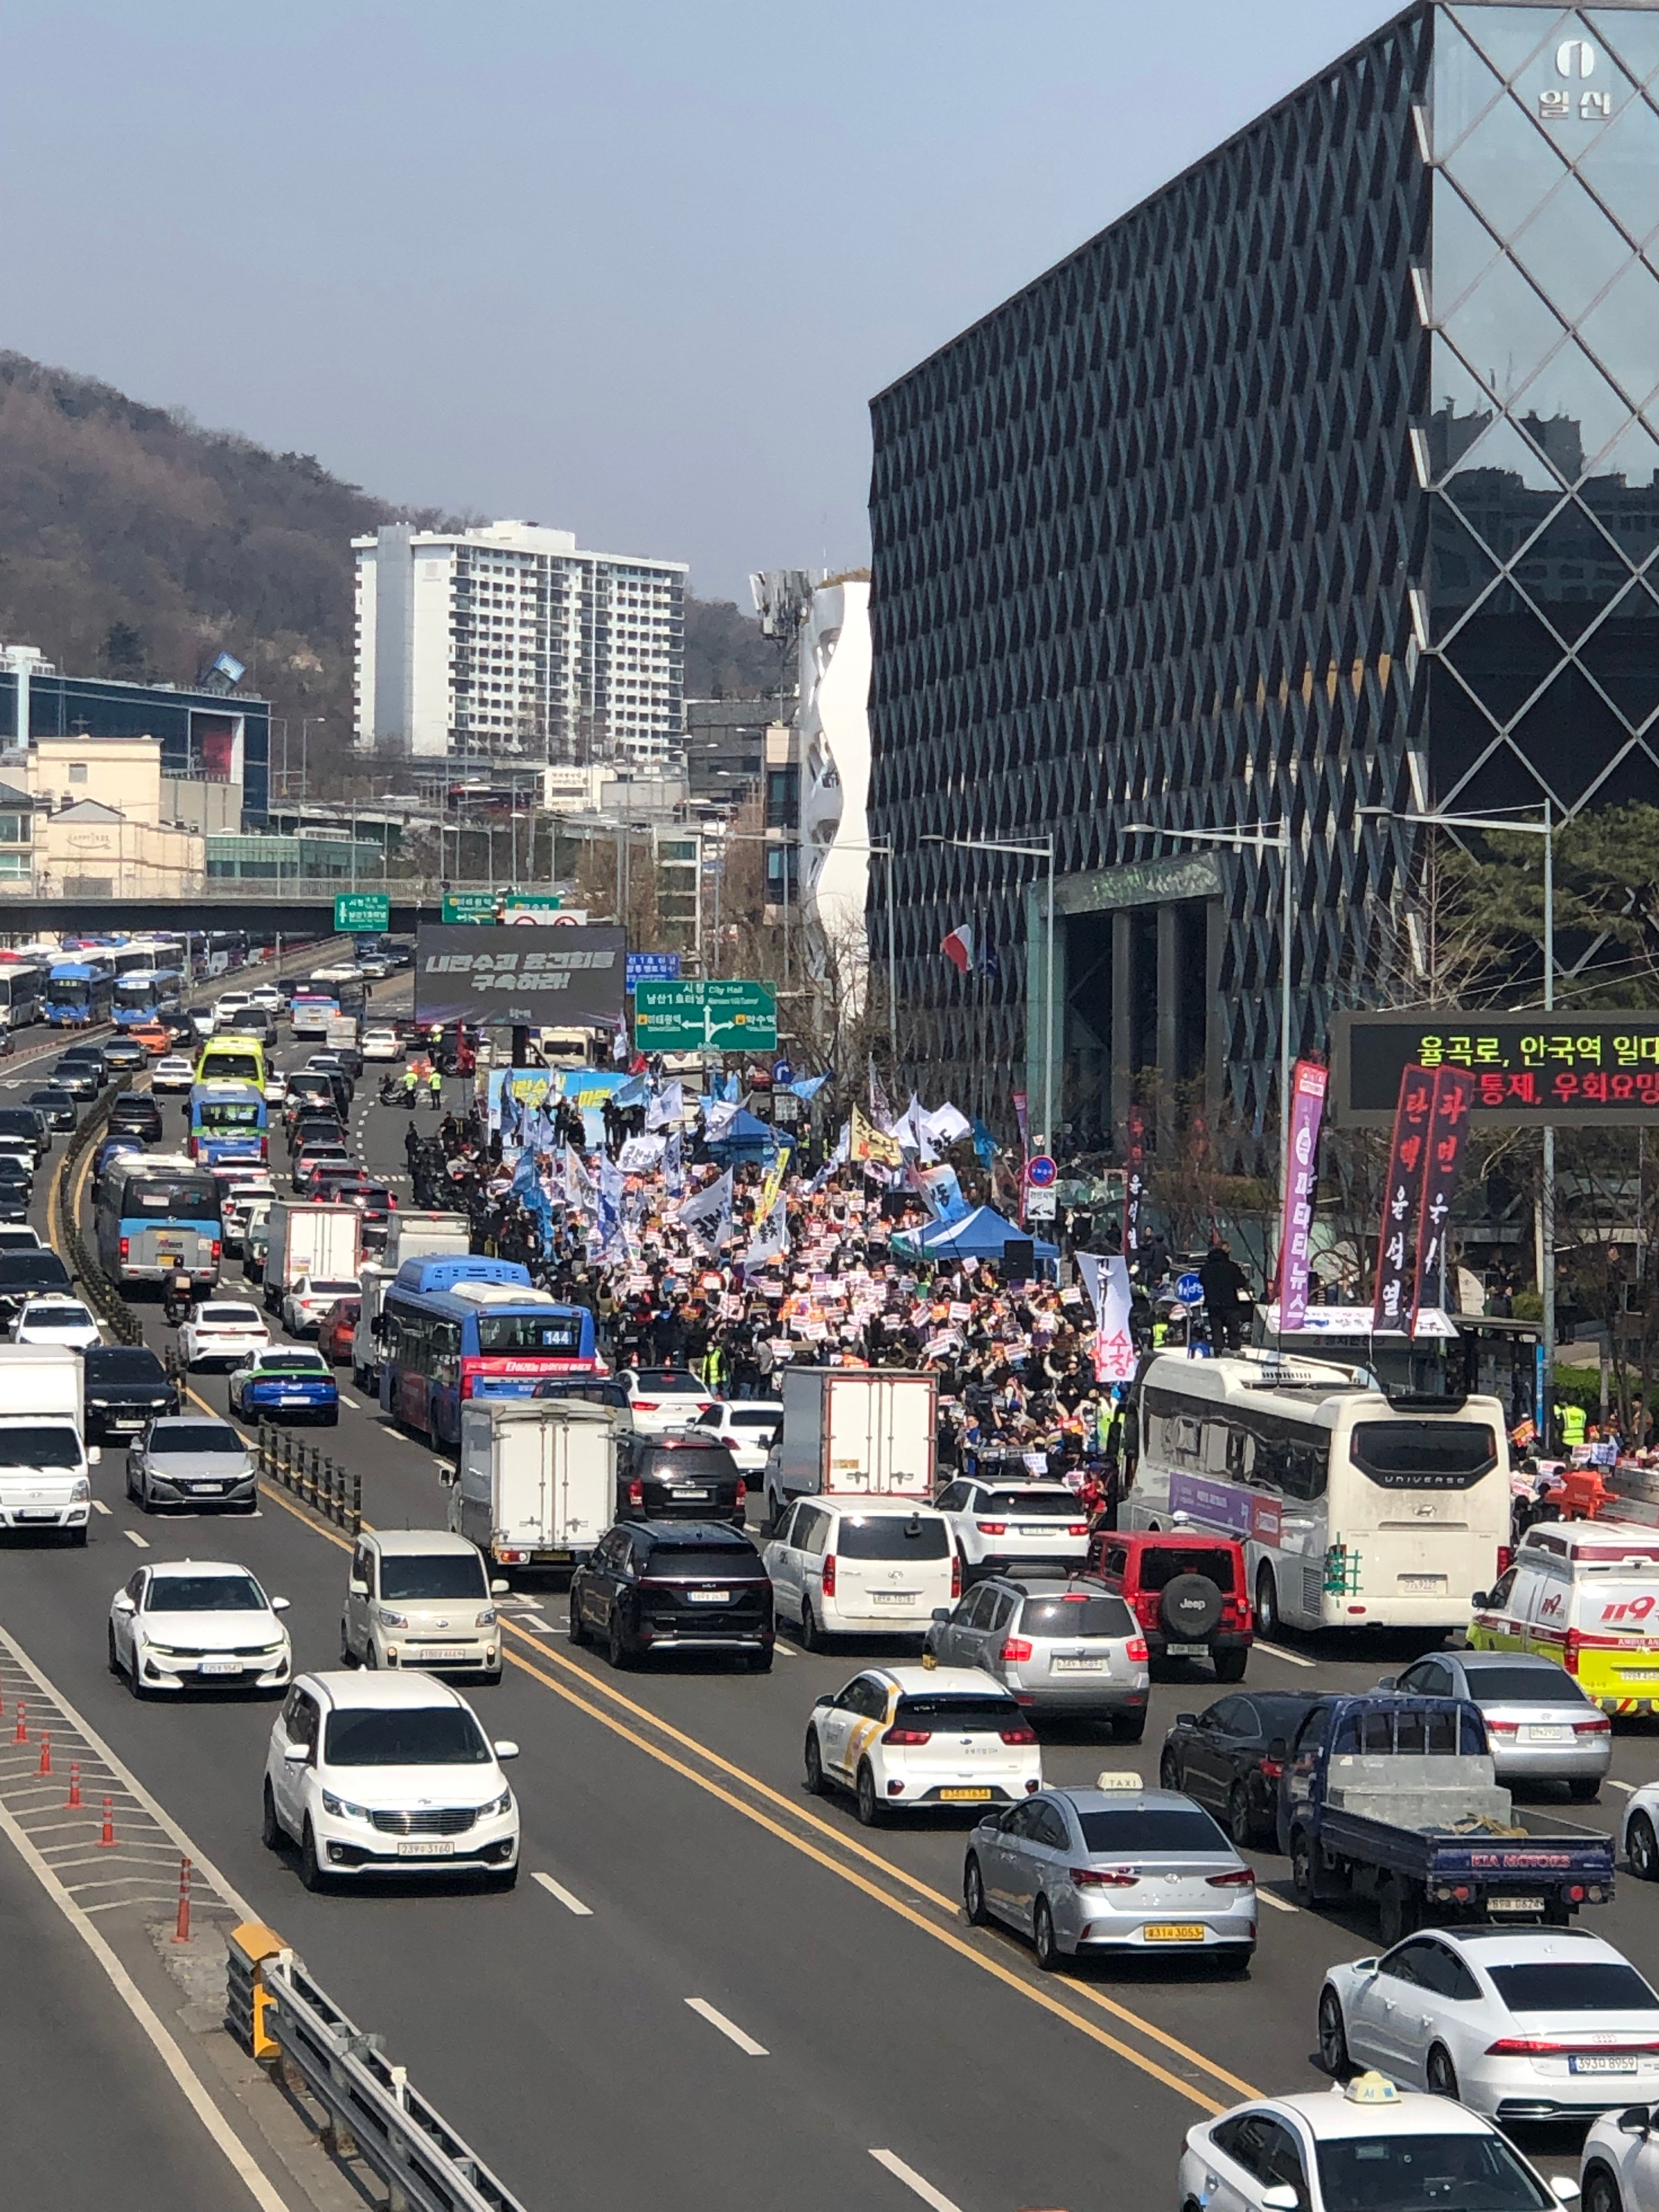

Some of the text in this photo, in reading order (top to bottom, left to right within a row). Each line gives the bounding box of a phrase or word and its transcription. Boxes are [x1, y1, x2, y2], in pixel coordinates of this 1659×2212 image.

[1539, 91, 1611, 119] 일신
[682, 983, 705, 994] 시청
[646, 994, 705, 1005] 남산1호터널
[1417, 1035, 1509, 1068] 율곡로,
[1520, 1035, 1602, 1066] 안국역
[1382, 1185, 1409, 1317] 윤석열
[546, 1331, 569, 1344] 144
[1180, 1598, 1206, 1610] Jeep
[1600, 1595, 1656, 1623] 119
[1110, 1779, 1137, 1787] TAXI
[1608, 2057, 1635, 2069] 8959
